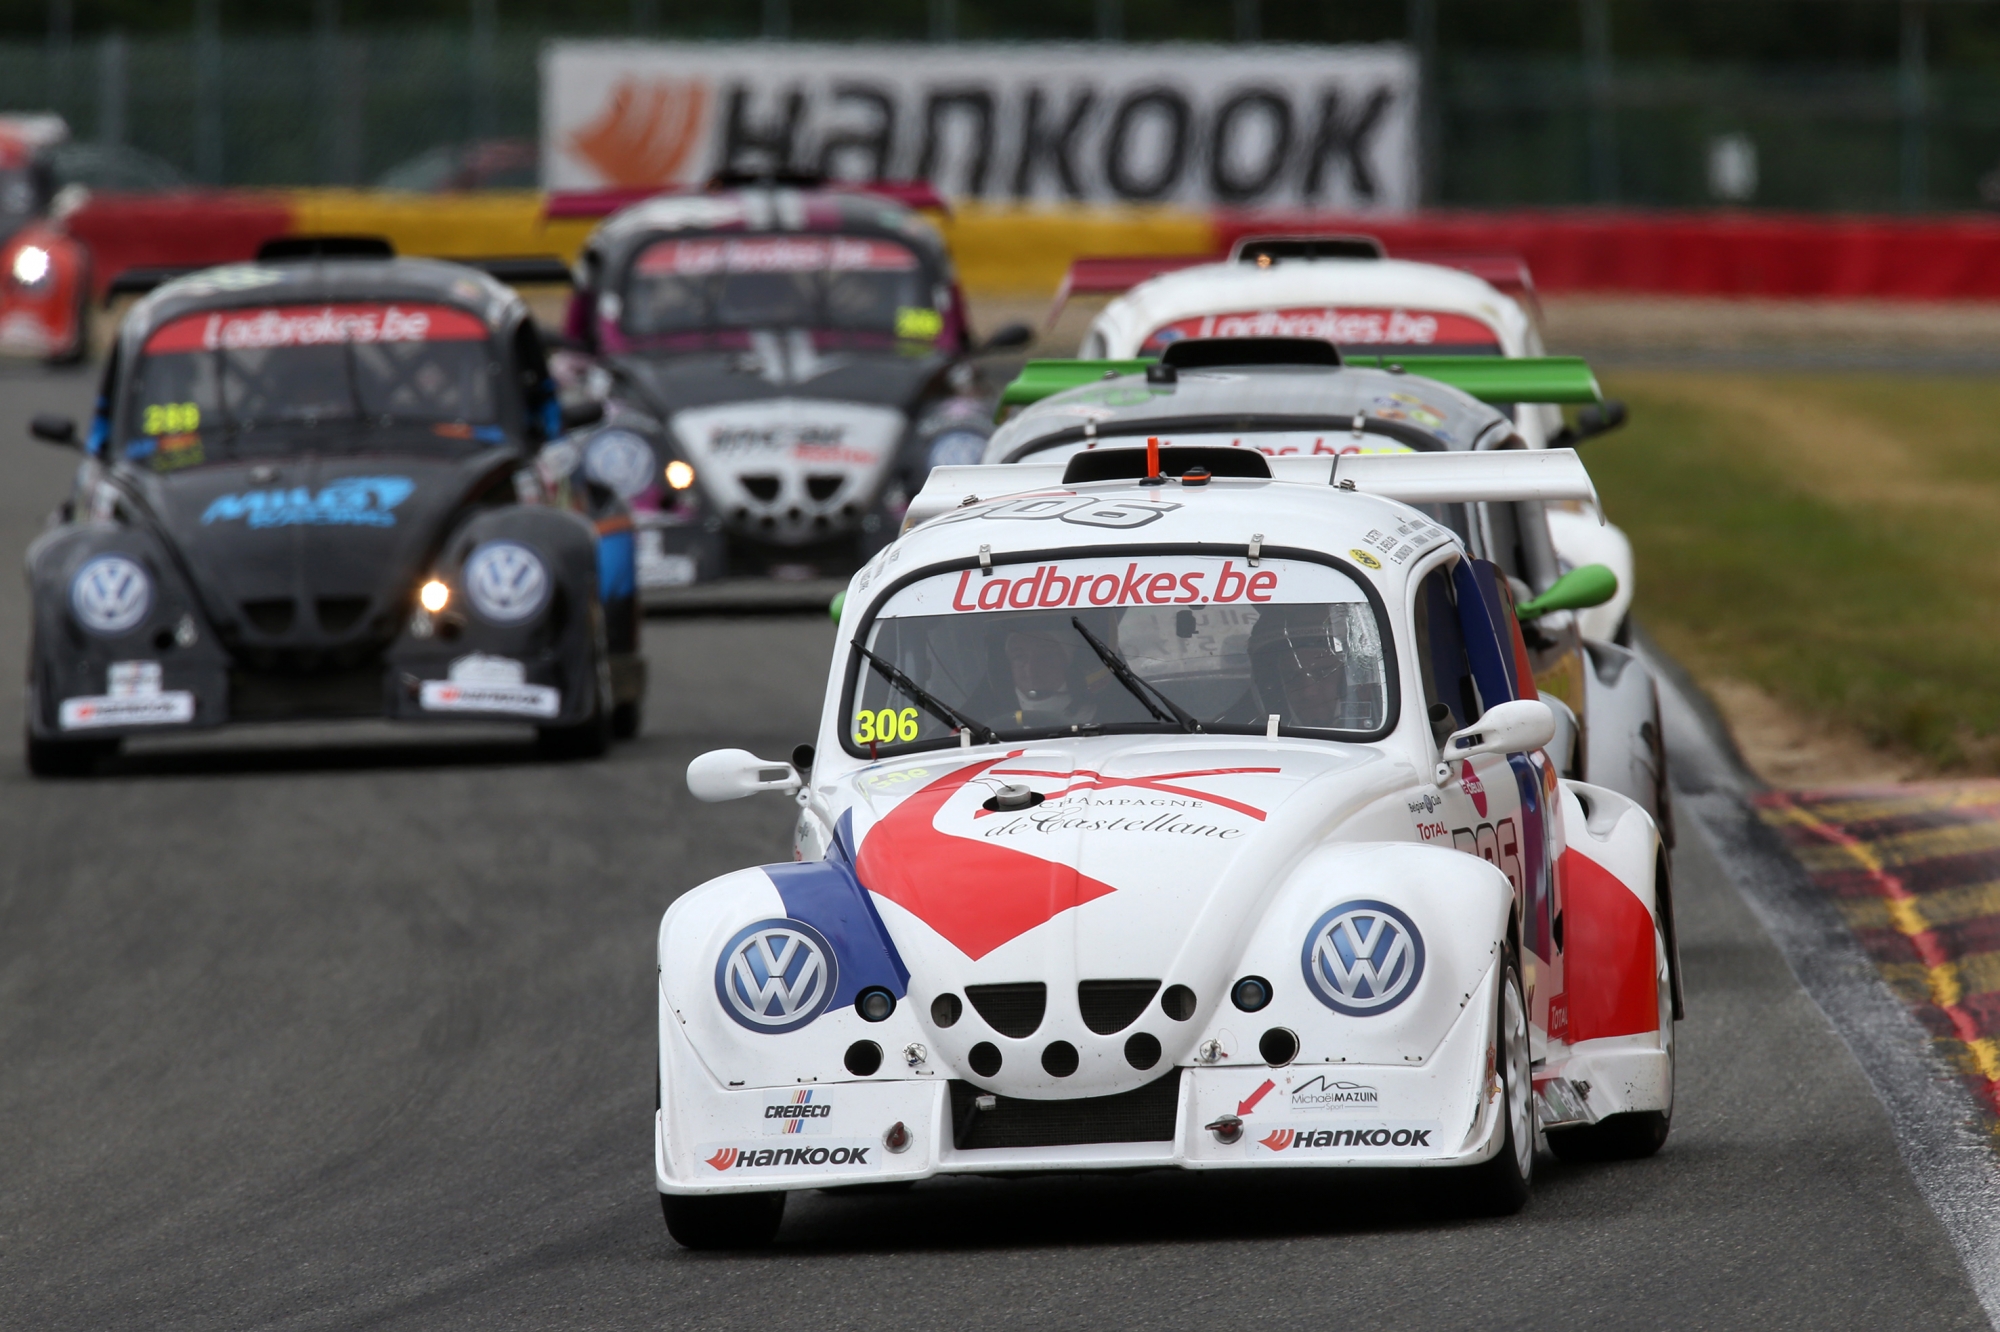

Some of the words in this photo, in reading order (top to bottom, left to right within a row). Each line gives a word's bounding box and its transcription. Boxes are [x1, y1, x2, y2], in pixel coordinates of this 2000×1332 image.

[951, 561, 1278, 612] Ladbrokes.be
[854, 707, 919, 744] 306
[1038, 795, 1204, 810] CHAMPAGNE
[984, 816, 1029, 838] de
[1029, 806, 1246, 840] Castellane
[1416, 821, 1448, 841] TOTAL
[764, 1104, 831, 1119] CREDECO
[1325, 1103, 1344, 1111] Sport
